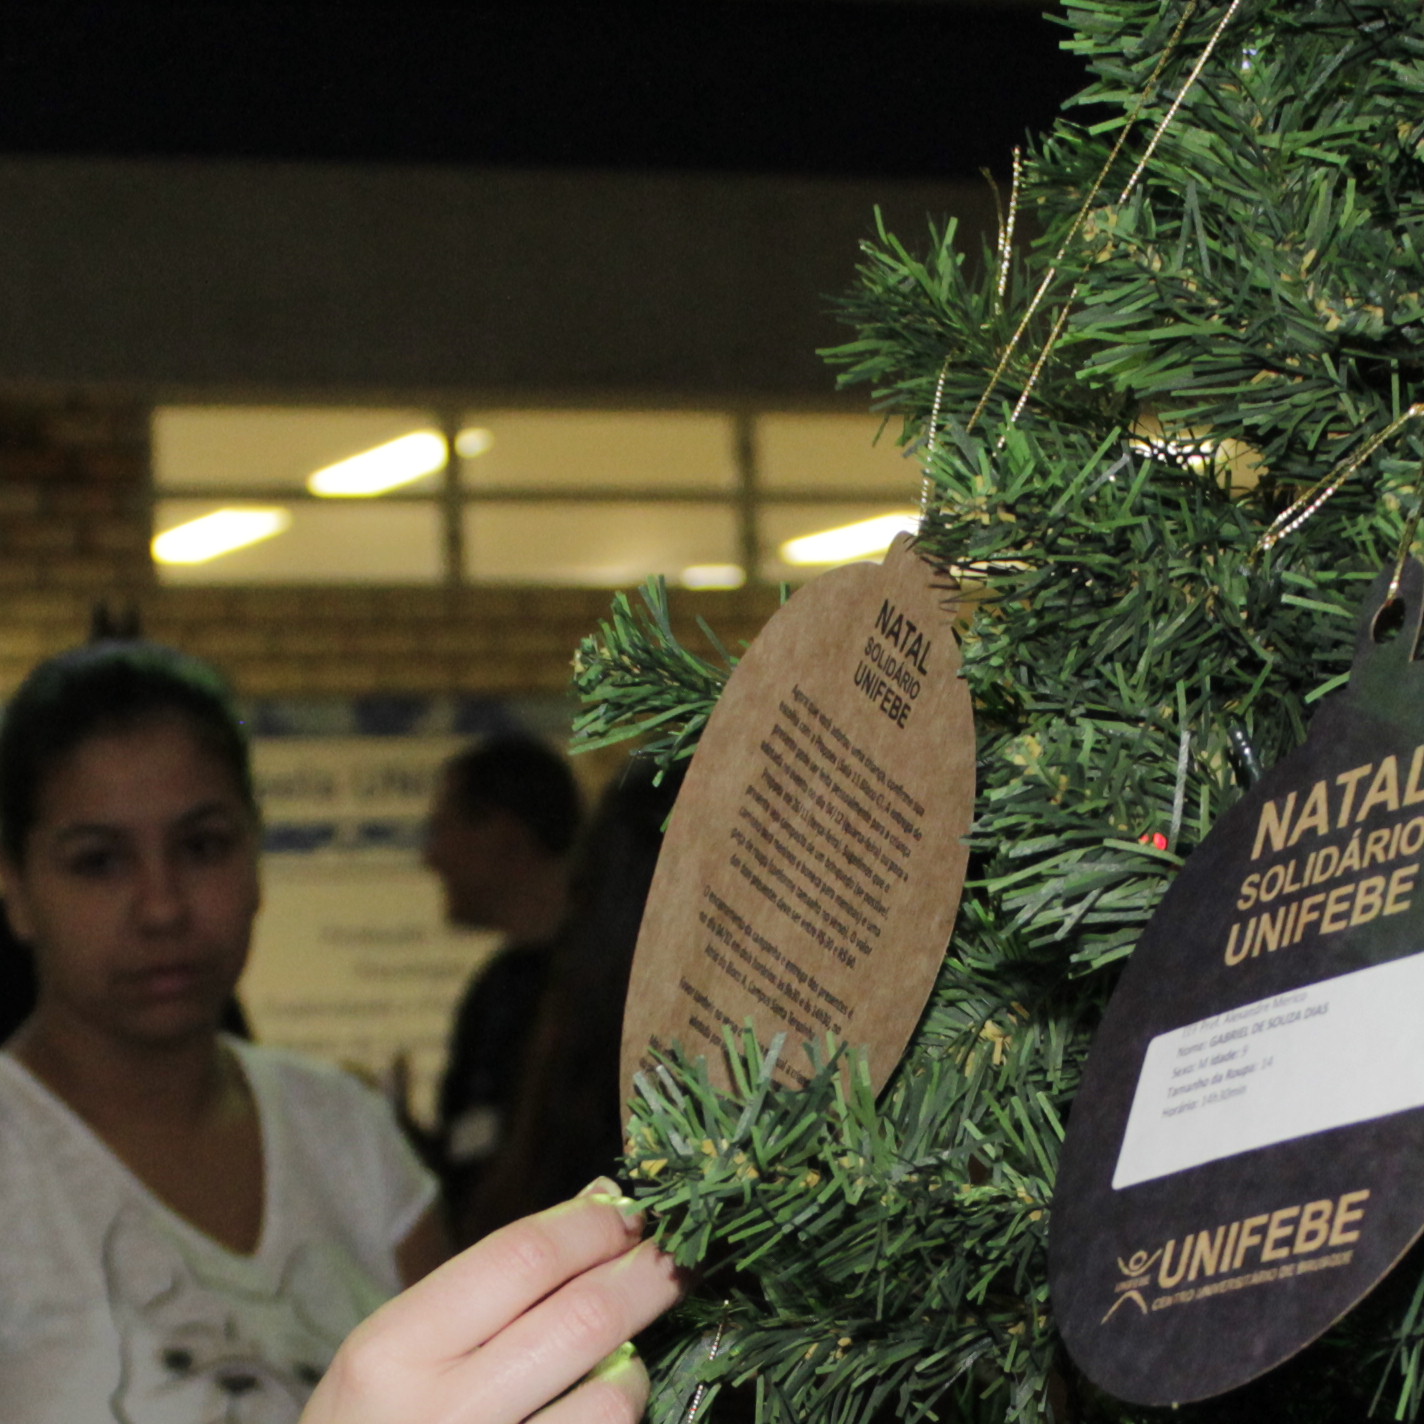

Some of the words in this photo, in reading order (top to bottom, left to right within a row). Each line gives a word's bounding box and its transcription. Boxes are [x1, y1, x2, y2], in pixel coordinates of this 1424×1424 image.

[865, 636, 921, 700] SOLIDÁRIO
[875, 599, 931, 676] NATAL
[854, 660, 911, 729] UNIFEBE
[1225, 863, 1419, 966] UNIFEBE
[1209, 1026, 1248, 1047] GABRIEL
[1251, 1021, 1264, 1035] DE
[1266, 1010, 1301, 1030] SOUZA
[1303, 1002, 1330, 1020] DIAS
[1158, 1189, 1370, 1288] UNIFEBE
